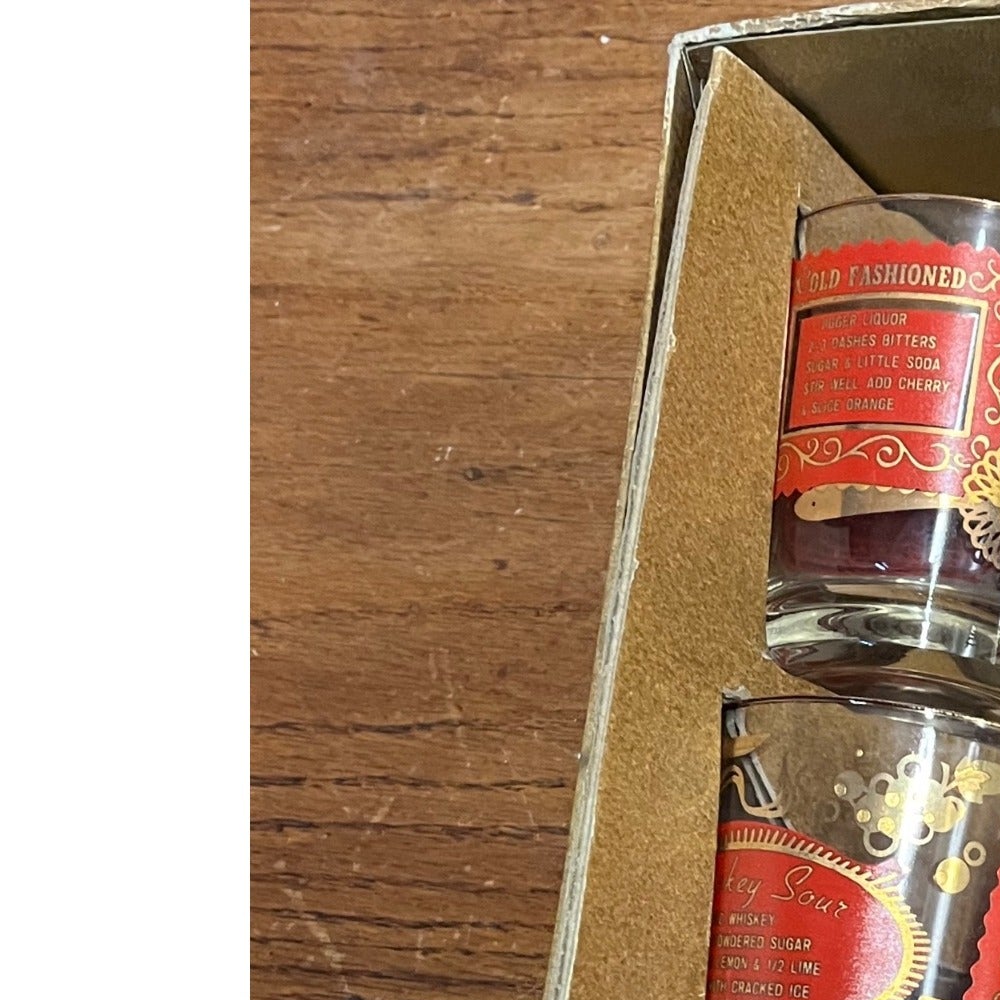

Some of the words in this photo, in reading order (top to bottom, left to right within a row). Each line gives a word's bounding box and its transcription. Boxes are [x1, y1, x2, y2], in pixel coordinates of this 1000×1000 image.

[848, 263, 967, 290] FASHIONED
[863, 312, 907, 326] LIQUOR
[832, 334, 876, 349] DASHES
[882, 334, 937, 349] BITTERS
[806, 358, 838, 373] SUGAR
[857, 354, 899, 369] LITTLE
[907, 356, 941, 371] SODA
[867, 377, 892, 390] ADD
[899, 377, 950, 394] CHERRY
[811, 401, 840, 414] SLICE
[846, 398, 894, 411] ORANGE
[771, 865, 848, 918] Sour
[729, 912, 775, 926] WHISKEY
[770, 937, 811, 951] SUGAR
[753, 958, 760, 971] &
[768, 960, 784, 973] 1/2
[791, 960, 821, 976] LIME
[732, 981, 783, 997] CRACKED
[790, 984, 810, 999] ICE
